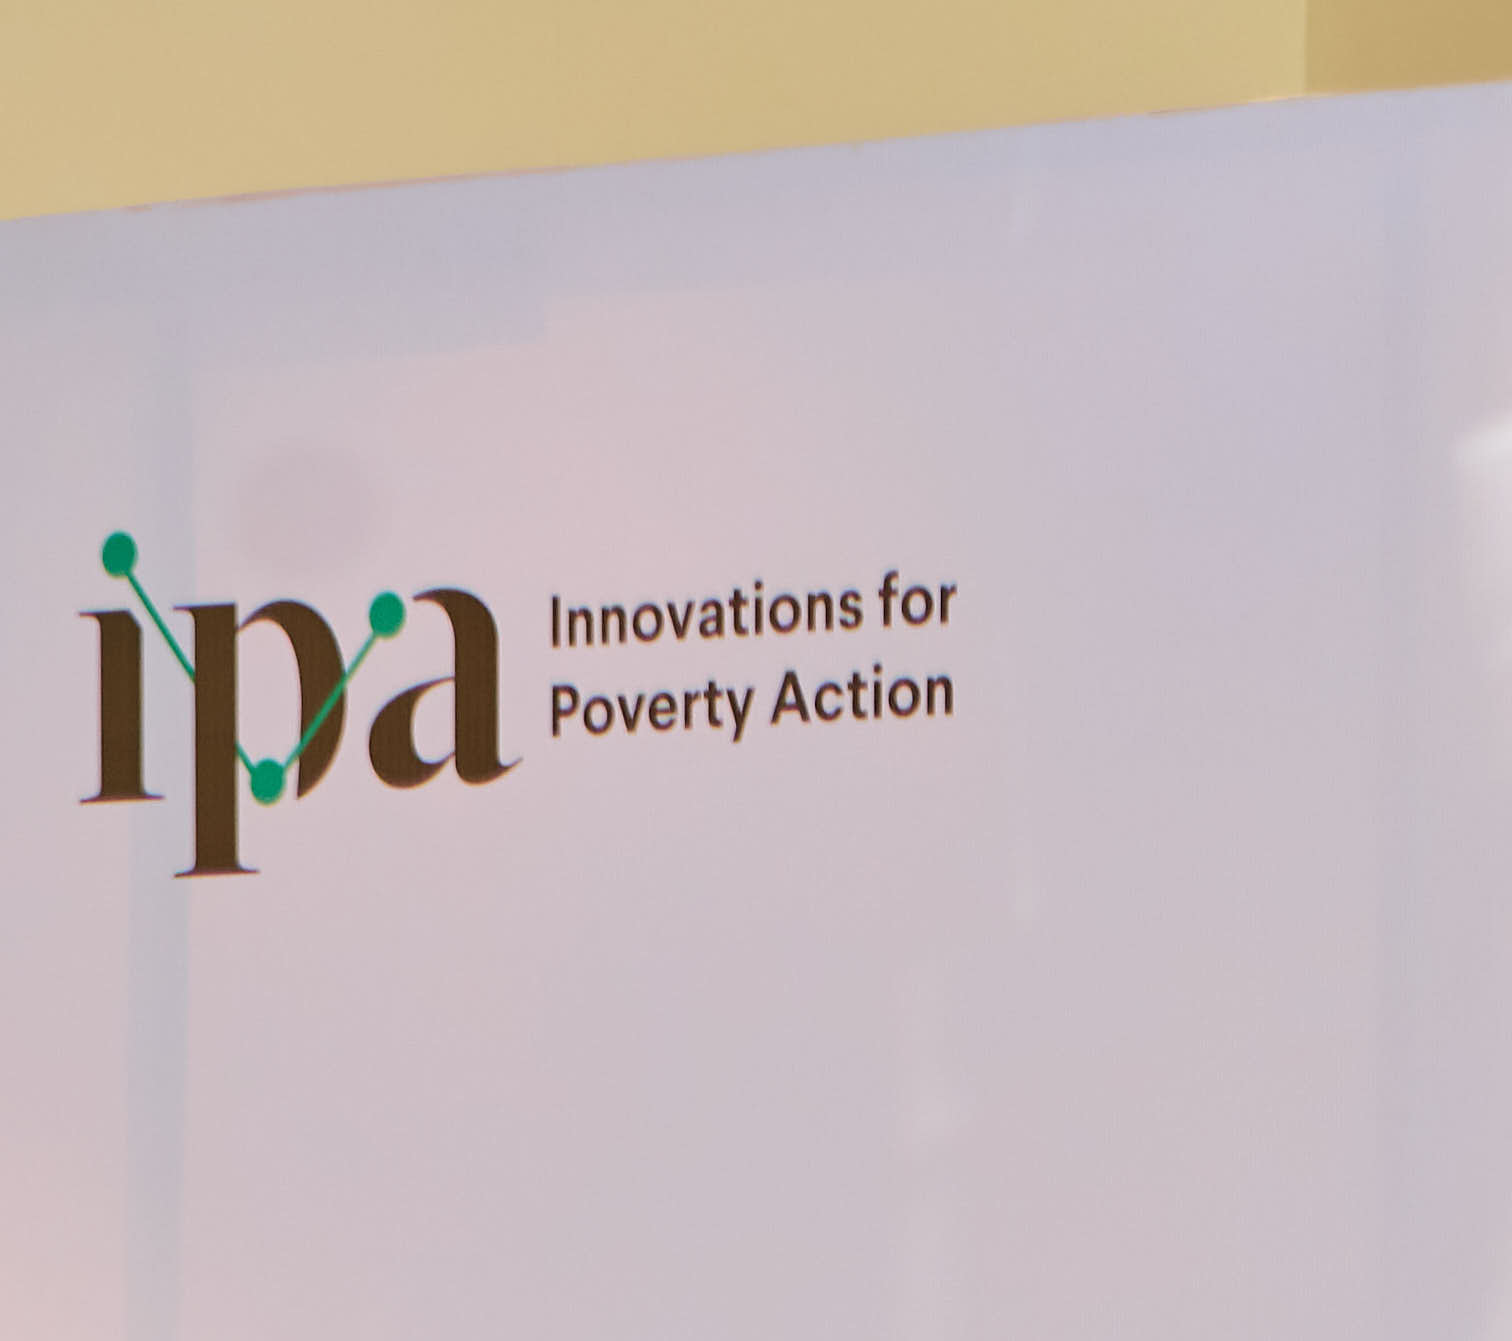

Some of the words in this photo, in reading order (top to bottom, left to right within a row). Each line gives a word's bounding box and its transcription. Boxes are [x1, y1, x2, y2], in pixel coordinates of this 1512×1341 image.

[551, 579, 864, 650] Innovations
[878, 569, 957, 629] for
[78, 531, 522, 878] ipa
[551, 679, 755, 744] Poverty
[770, 662, 953, 727] Action
